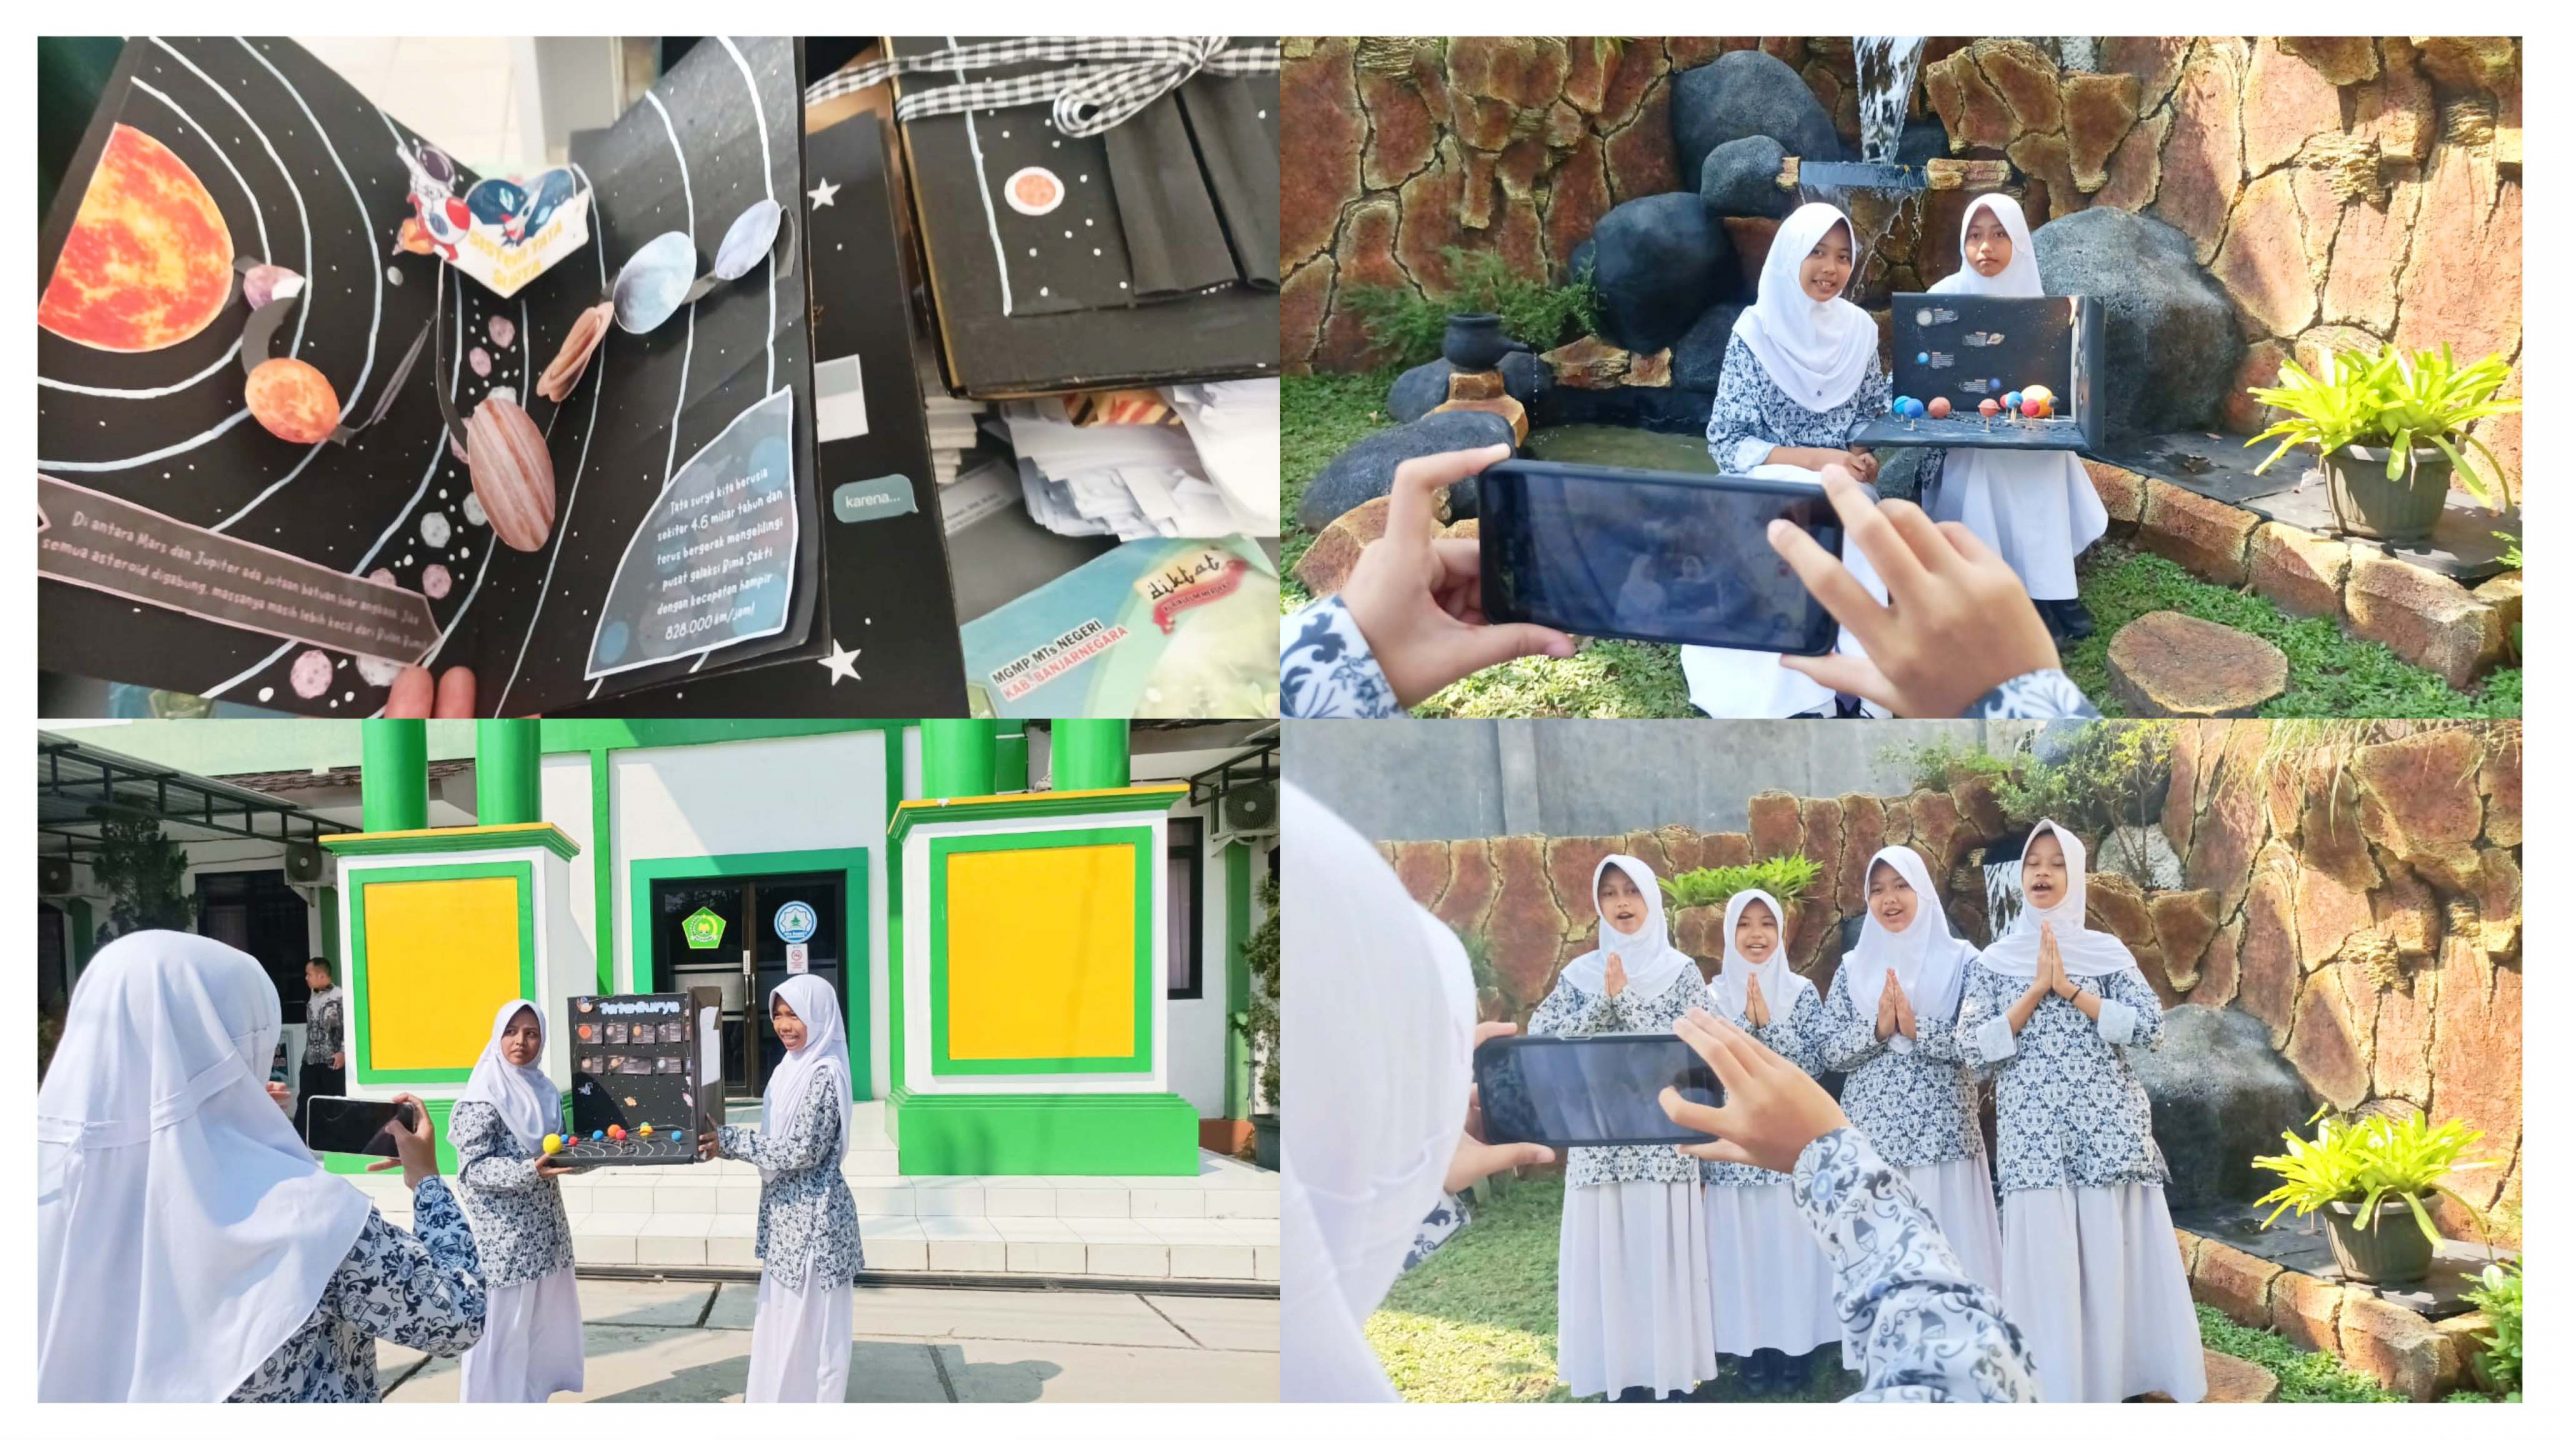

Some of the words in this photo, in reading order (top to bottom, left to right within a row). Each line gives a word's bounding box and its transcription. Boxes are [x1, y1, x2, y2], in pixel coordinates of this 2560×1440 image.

[657, 523, 688, 542] sekitar
[710, 507, 736, 523] miliar
[737, 497, 764, 515] tahun
[766, 489, 783, 504] dan
[670, 500, 688, 515] Tata
[691, 490, 715, 506] surya
[716, 483, 734, 498] kita
[735, 468, 768, 488] berusia
[72, 511, 88, 527] Di
[91, 519, 135, 542] antara
[135, 532, 167, 554] Mars
[170, 545, 192, 560] dan
[194, 551, 240, 574] Jupiter
[242, 567, 262, 582] ada
[657, 550, 681, 565] terus
[683, 536, 724, 555] bergerak
[726, 517, 783, 544] mengelilingi
[41, 538, 88, 559] semua
[91, 550, 149, 577] asteroid
[211, 586, 265, 611] massanya
[267, 601, 298, 618] masih
[657, 598, 689, 615] dengan
[690, 583, 738, 607] kecepatan
[739, 573, 773, 592] hampir
[662, 571, 688, 592] pusat
[690, 563, 720, 582] galaksi
[722, 557, 744, 573] Bima
[746, 547, 773, 565] Sakti
[1150, 553, 1219, 600] diktat
[992, 658, 1031, 684] MGMP
[1031, 646, 1058, 663] MTs
[1056, 620, 1102, 650] NEGERI
[1033, 626, 1128, 682] BANJARNEGARA
